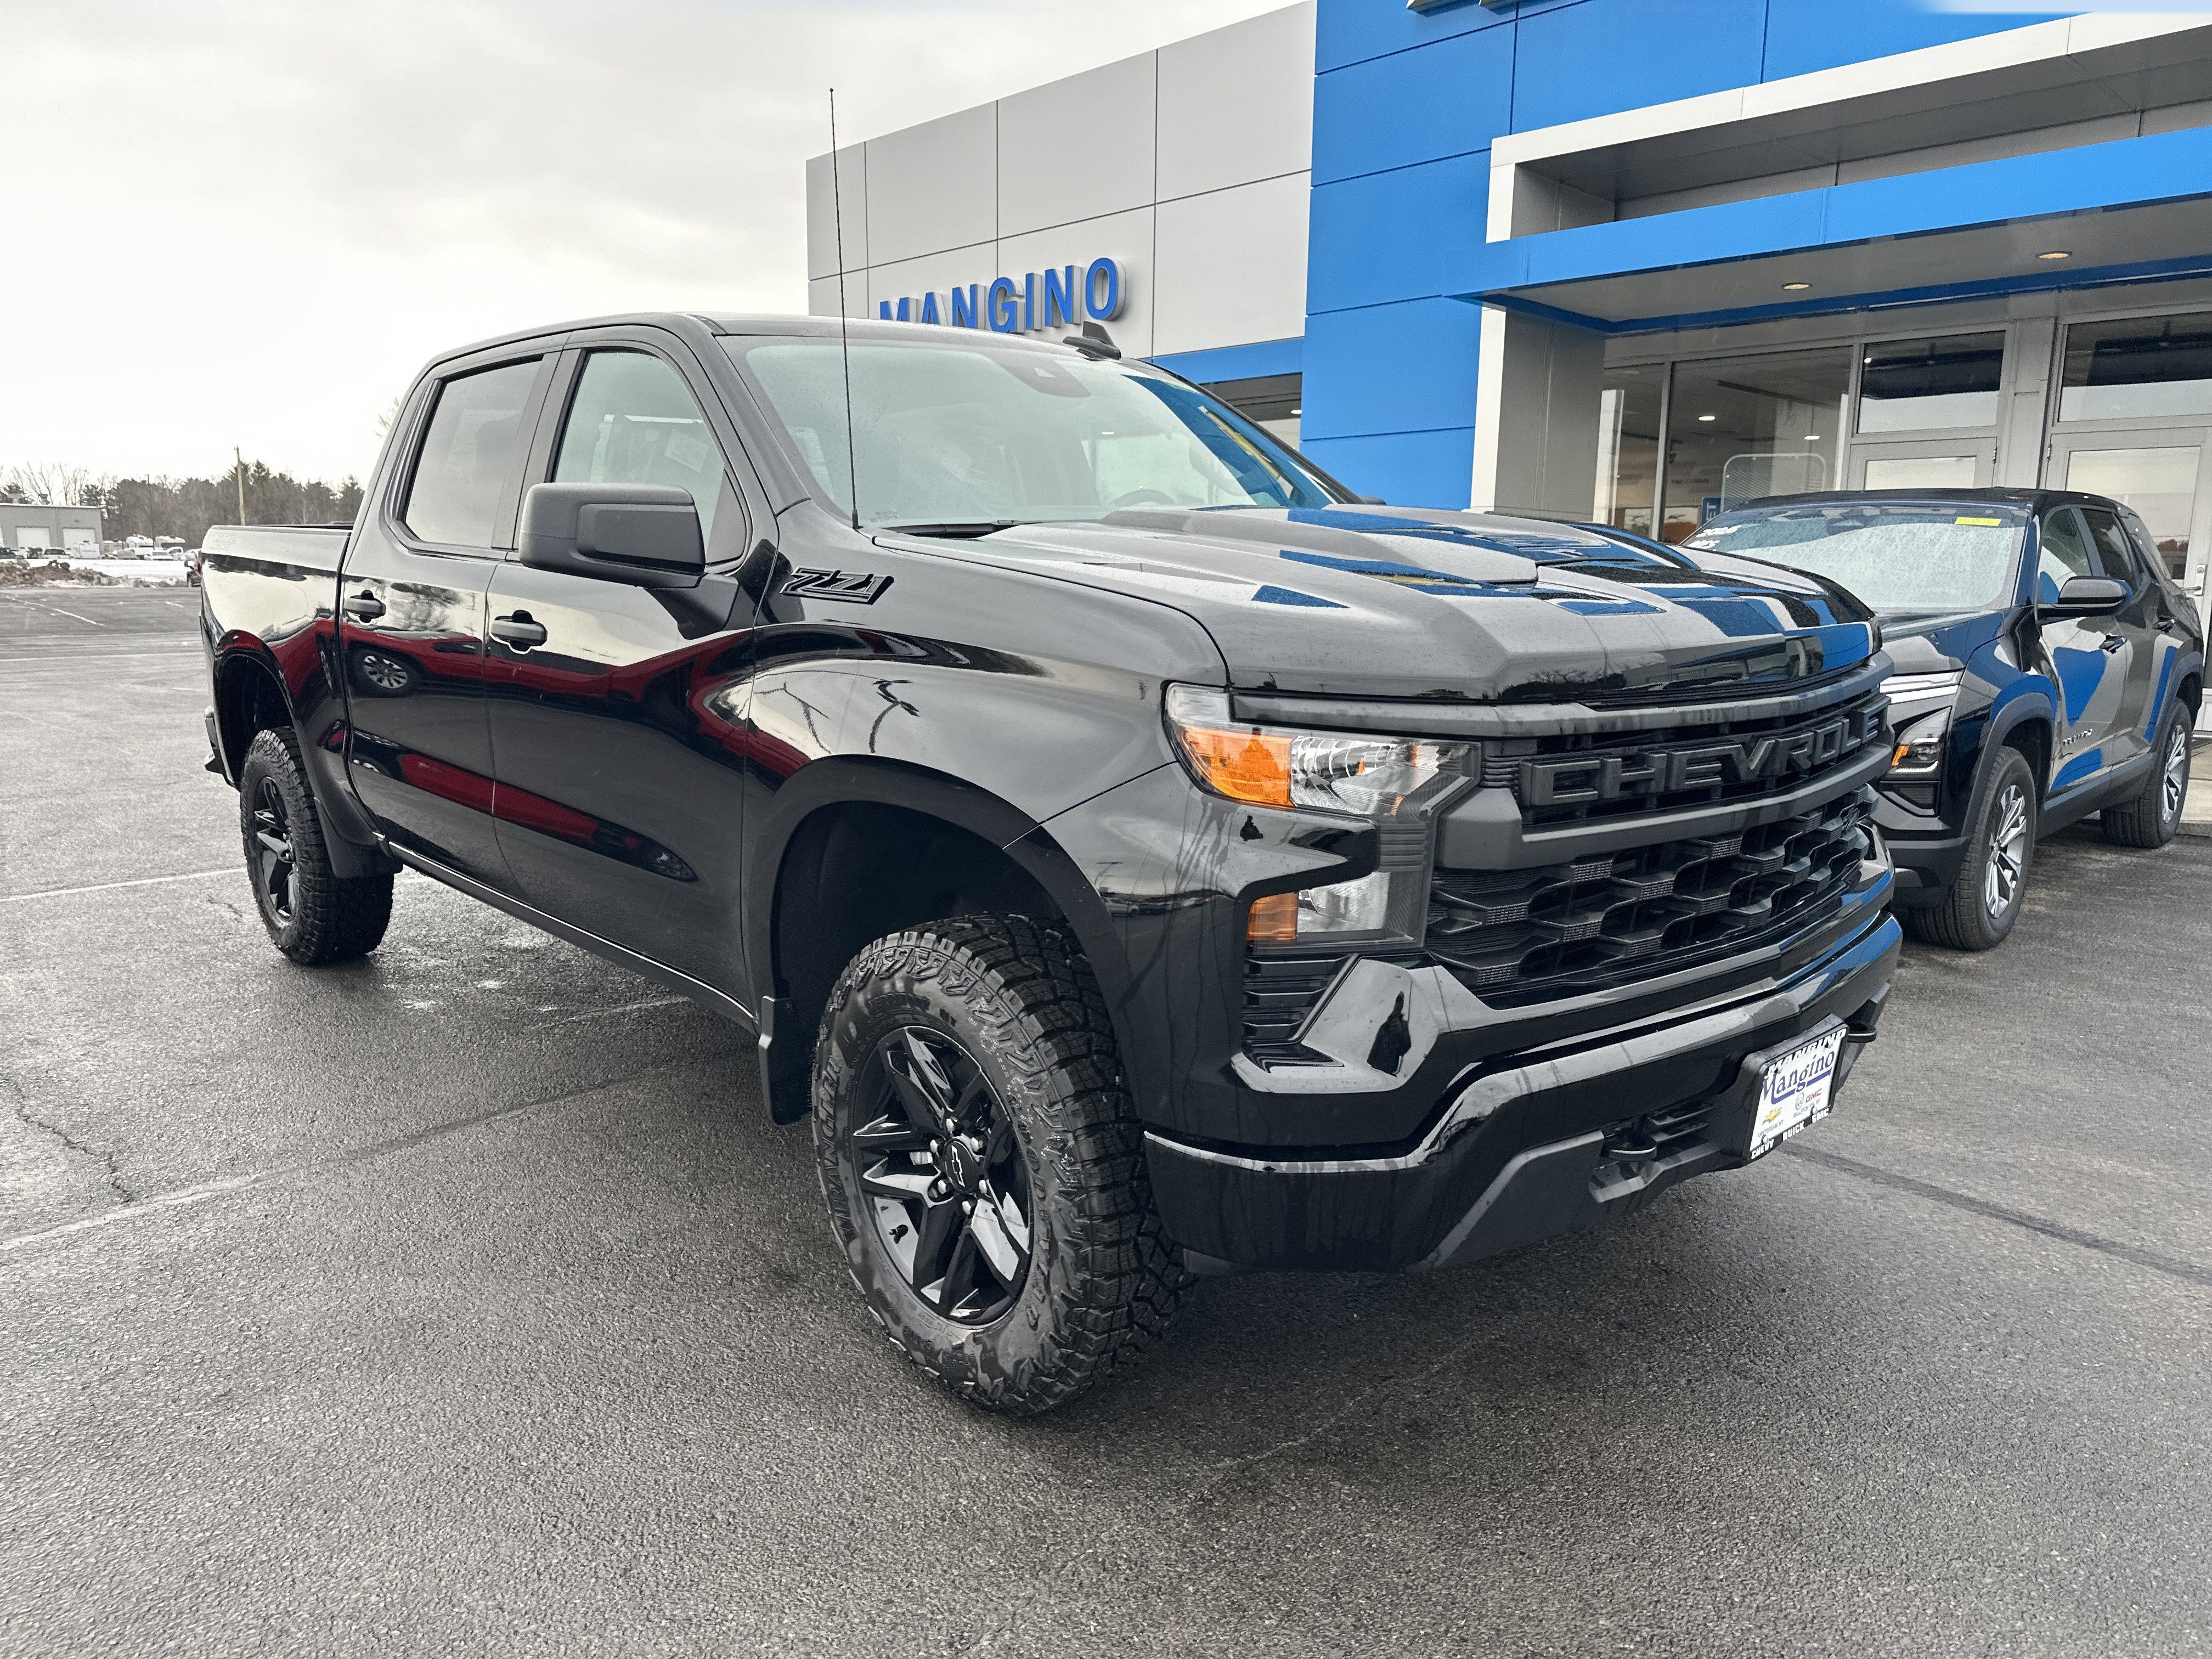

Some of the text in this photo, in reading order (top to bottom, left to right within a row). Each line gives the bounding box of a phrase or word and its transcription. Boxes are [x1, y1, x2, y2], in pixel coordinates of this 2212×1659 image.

[880, 257, 1122, 334] MANGINO
[780, 565, 894, 605] Z71
[1762, 1051, 1835, 1105] Mangino
[1805, 1088, 1822, 1103] GMC
[1751, 1108, 1830, 1160] CHEVY BUICK GMC
